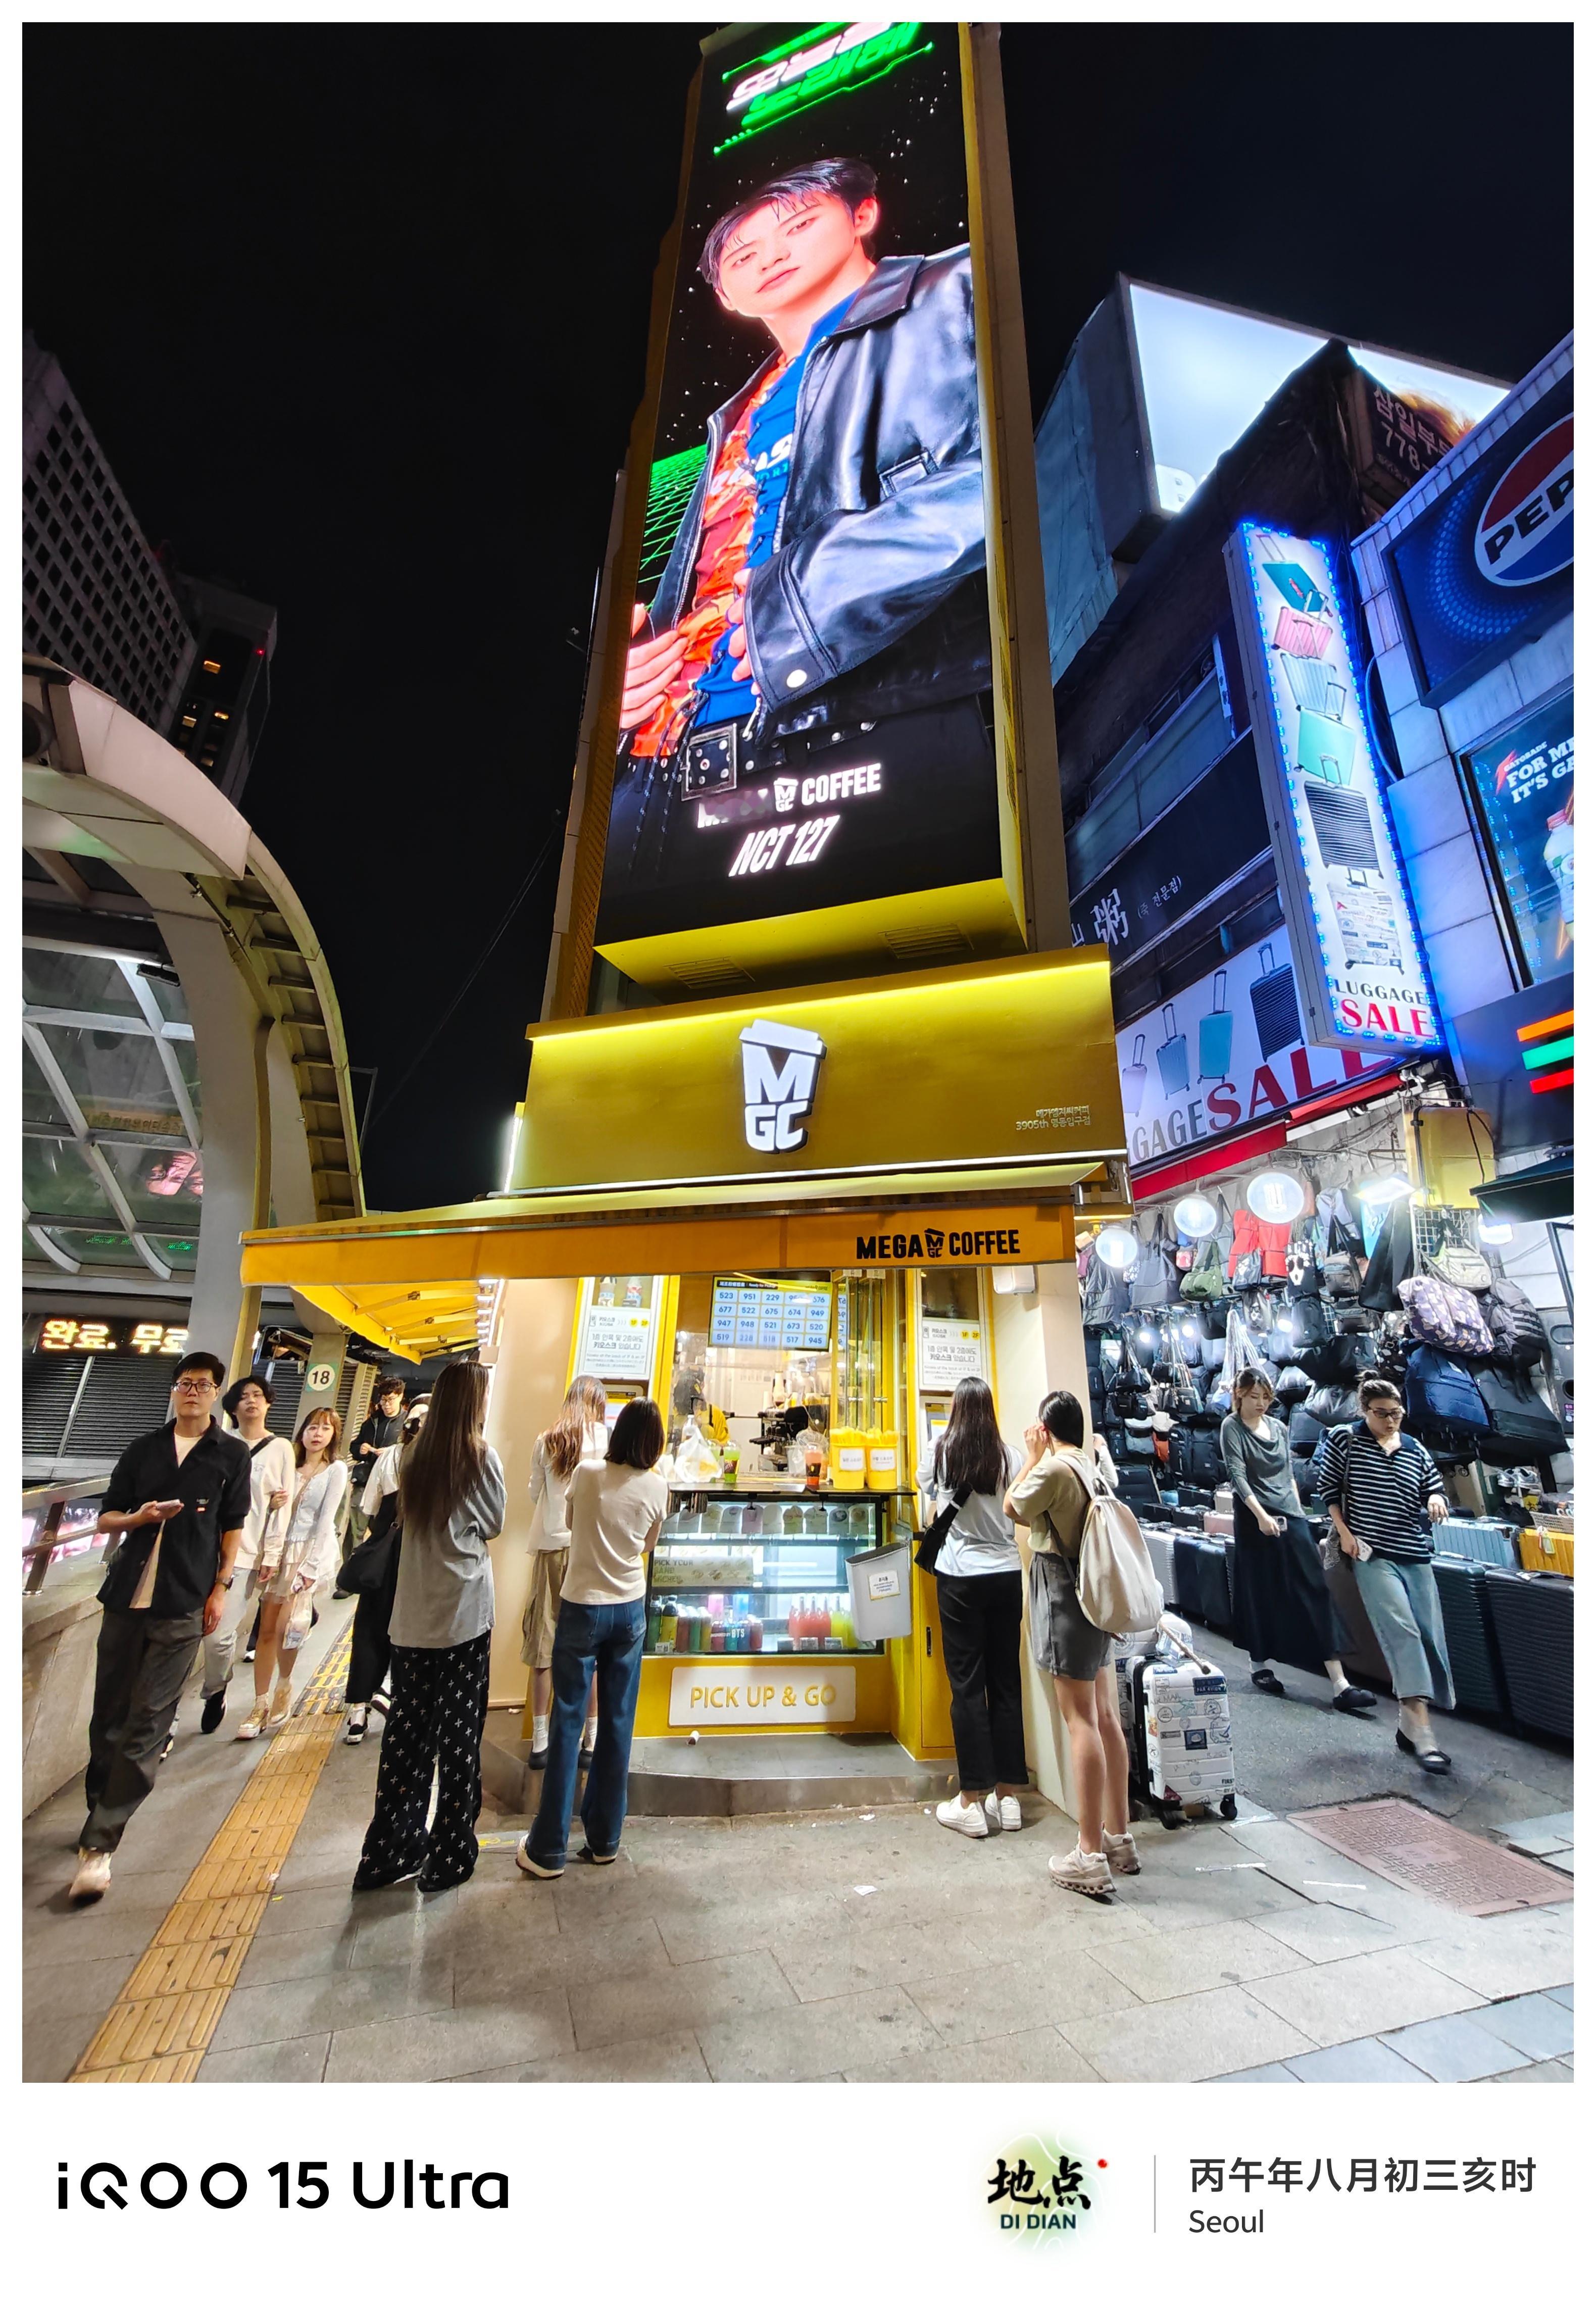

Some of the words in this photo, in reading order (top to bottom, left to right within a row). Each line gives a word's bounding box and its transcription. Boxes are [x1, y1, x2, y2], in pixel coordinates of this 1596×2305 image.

[1484, 469, 1574, 565] PEP
[1504, 741, 1548, 772] GATORADE
[1506, 756, 1548, 788] FOR
[802, 763, 881, 806] COFFEE
[1511, 772, 1549, 804] IT'S
[728, 824, 795, 877] NCT
[786, 815, 840, 866] 127
[1152, 875, 1181, 907] 전문점)
[1335, 978, 1426, 1006] LUGGAGE
[1341, 998, 1434, 1037] SALE
[1016, 1119, 1049, 1131] 3905th
[1051, 1115, 1091, 1128] 명동입구점
[1126, 1099, 1208, 1163] GAGE
[856, 1234, 924, 1260] MEGA
[949, 1229, 1021, 1257] COFFEE
[42, 1319, 117, 1350] 완료.
[312, 1370, 330, 1385] 18
[731, 1628, 744, 1638] BTS
[690, 1686, 740, 1709] PICK
[746, 1685, 775, 1708] UP
[781, 1685, 797, 1707] &
[805, 1684, 837, 1706] GO
